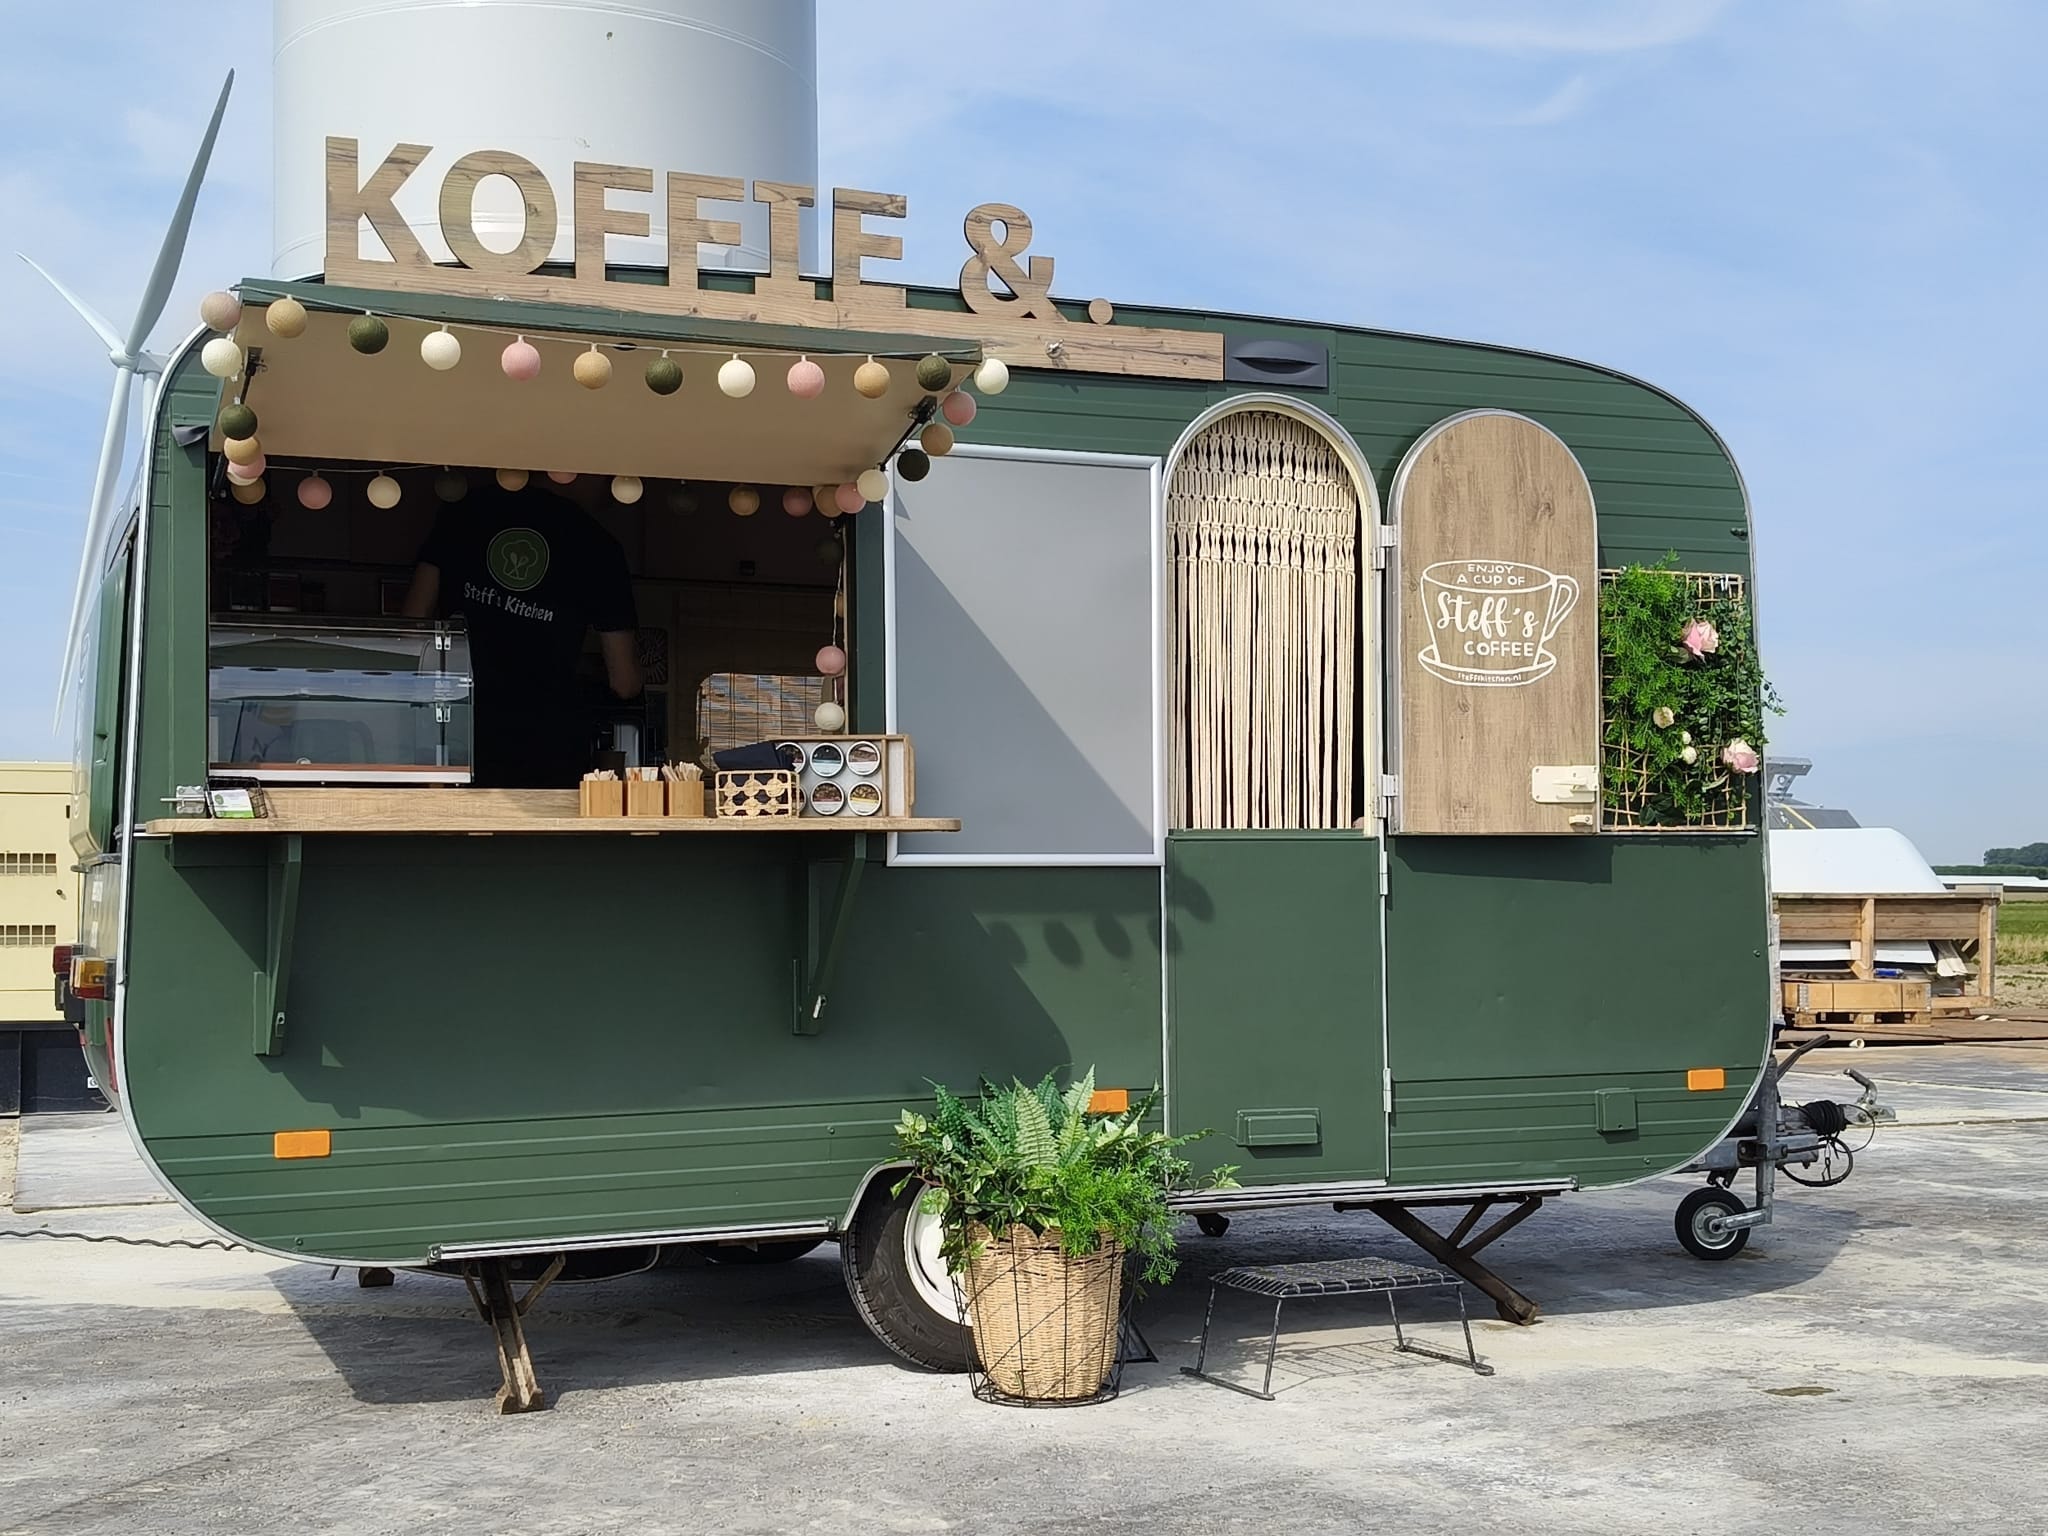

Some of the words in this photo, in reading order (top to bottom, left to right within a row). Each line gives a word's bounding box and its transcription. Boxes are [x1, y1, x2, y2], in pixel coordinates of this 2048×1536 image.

[326, 136, 907, 306] KOFFIE
[1467, 563, 1514, 574] ENJOY
[1456, 574, 1468, 584] A
[1473, 574, 1503, 586] CUP
[1507, 575, 1526, 586] OF
[504, 595, 554, 621] Kitchen
[1437, 591, 1539, 639] Steff's
[1463, 641, 1535, 657] COFFEE
